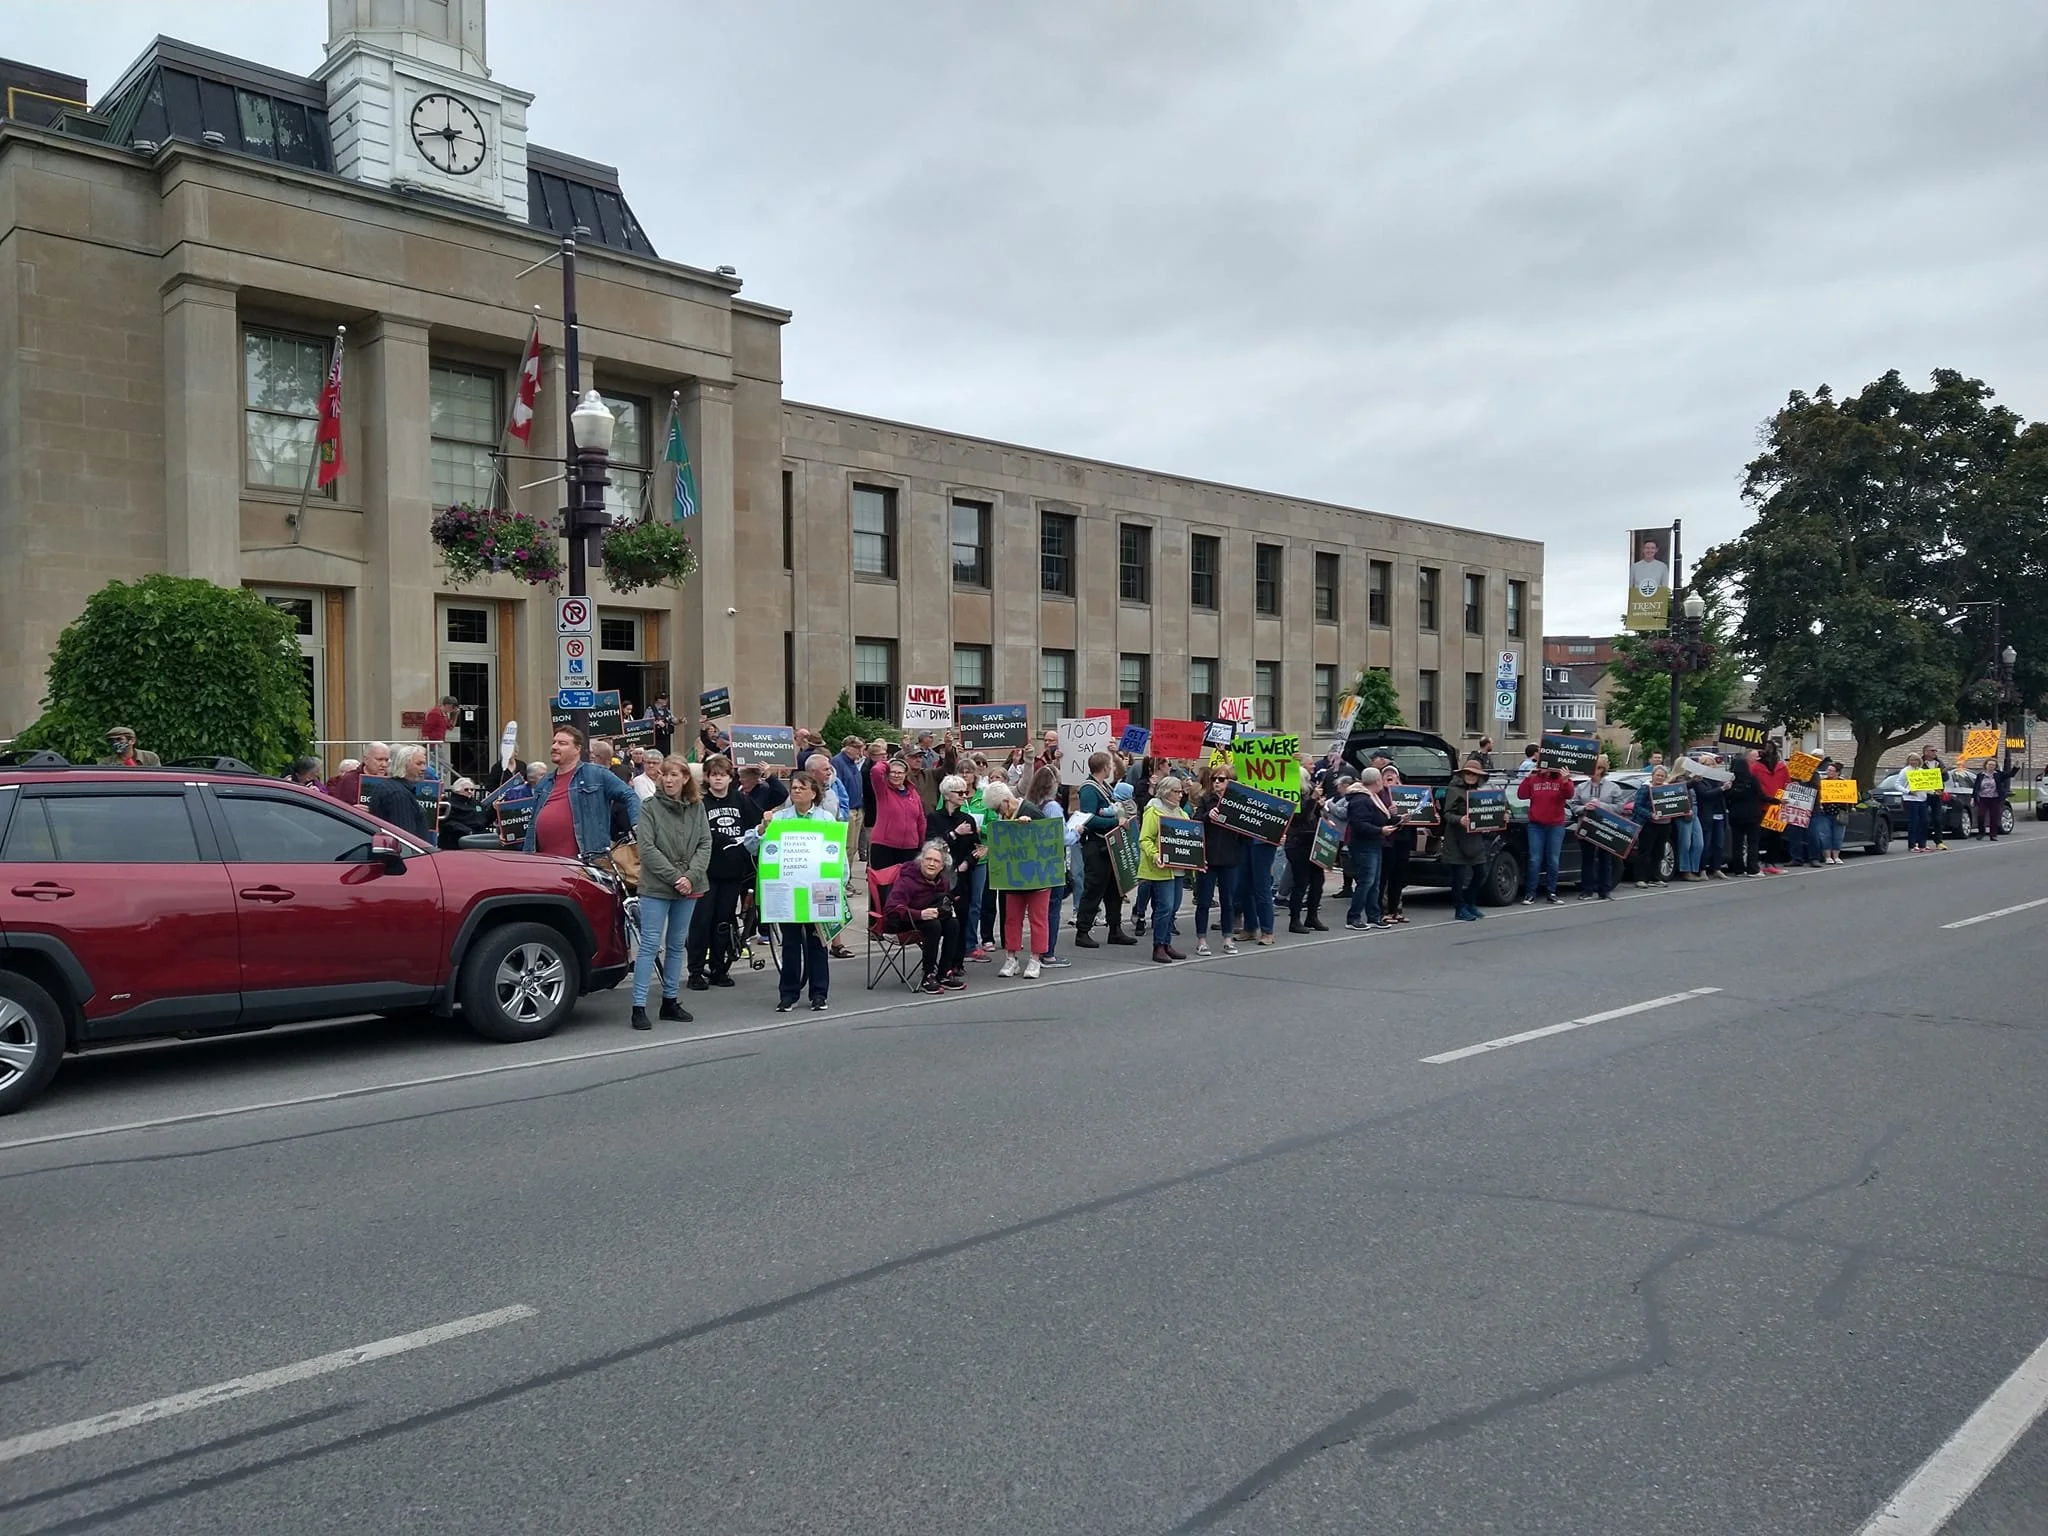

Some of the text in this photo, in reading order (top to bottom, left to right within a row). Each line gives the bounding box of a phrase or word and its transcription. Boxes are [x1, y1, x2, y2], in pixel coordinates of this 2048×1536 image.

[1631, 602, 1664, 611] TRENT
[908, 687, 946, 704] UNITE
[1219, 698, 1252, 720] SAVE
[960, 722, 1027, 731] BONNERWORTH
[1127, 729, 1146, 741] GET
[1725, 723, 1765, 744] HONK
[732, 742, 794, 750] BONNERWORTH
[1077, 742, 1096, 752] SAY
[1231, 738, 1300, 756] WE WERE
[1560, 743, 1579, 751] SAVE
[2006, 738, 2024, 748] HONK
[1540, 748, 1597, 760] BONNERWORTH
[1557, 757, 1577, 765] PARK
[1245, 758, 1292, 782] NOT
[1246, 797, 1269, 810] SAVE
[1220, 797, 1289, 826] BONNERWORTH
[1238, 813, 1263, 827] PARK
[1174, 828, 1190, 837] SAVE
[1160, 835, 1204, 848] BONNERWORTH
[1175, 847, 1191, 856] PARK
